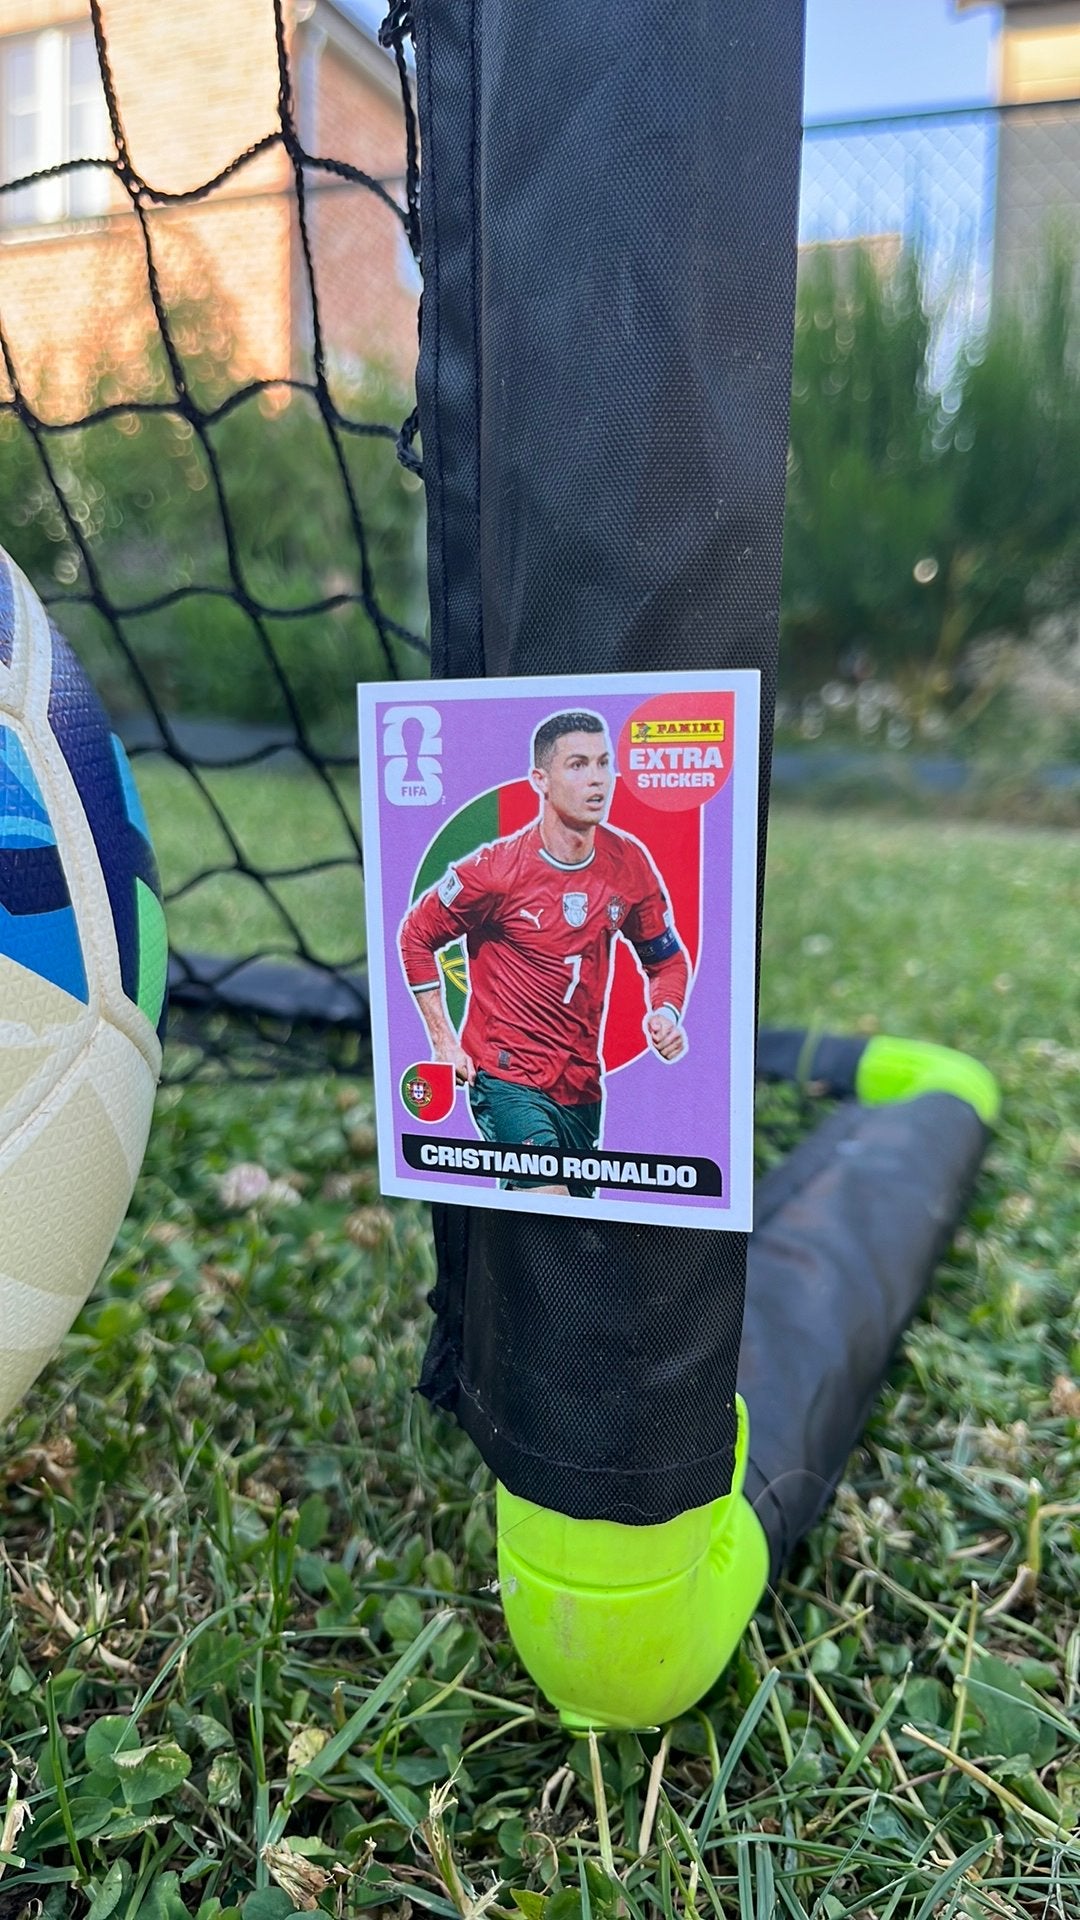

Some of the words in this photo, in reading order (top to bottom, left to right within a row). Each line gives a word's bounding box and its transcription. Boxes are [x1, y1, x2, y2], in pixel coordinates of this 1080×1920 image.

[657, 723, 720, 734] PANINI
[629, 746, 724, 770] EXTRA
[637, 772, 716, 788] STICKER
[401, 786, 428, 797] FIFA
[564, 954, 583, 1004] 7
[420, 1144, 559, 1177] CRISTIANO
[562, 1157, 697, 1188] RONALDO
